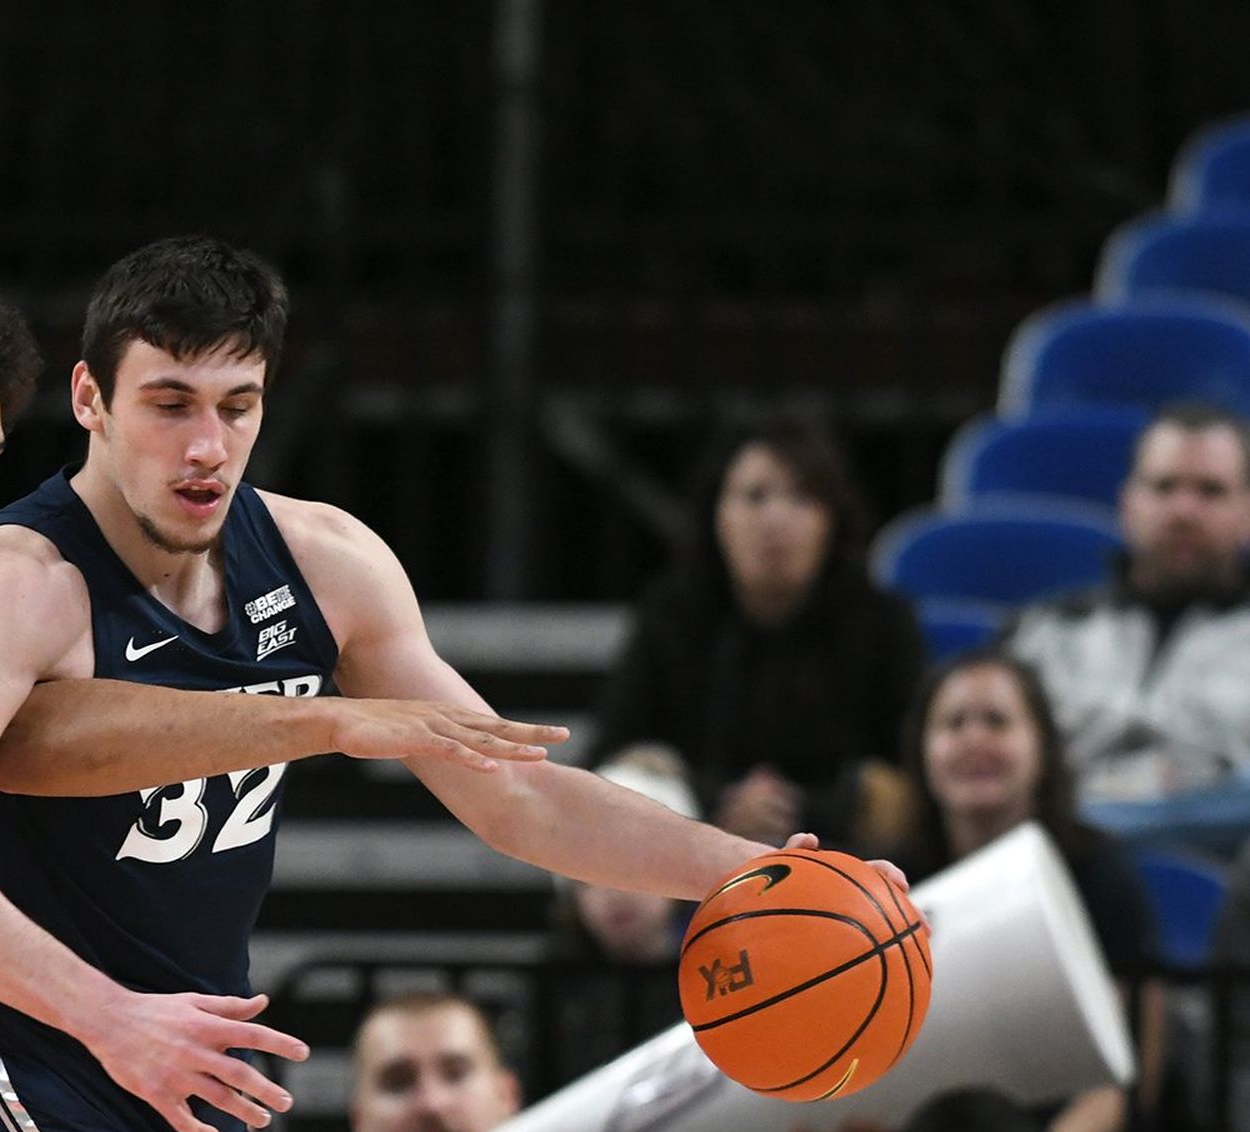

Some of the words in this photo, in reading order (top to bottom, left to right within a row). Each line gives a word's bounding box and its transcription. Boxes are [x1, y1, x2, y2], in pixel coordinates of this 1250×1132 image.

[250, 598, 296, 624] CHANGE
[257, 627, 297, 655] EAST
[258, 620, 287, 643] BIG
[115, 761, 287, 864] 32
